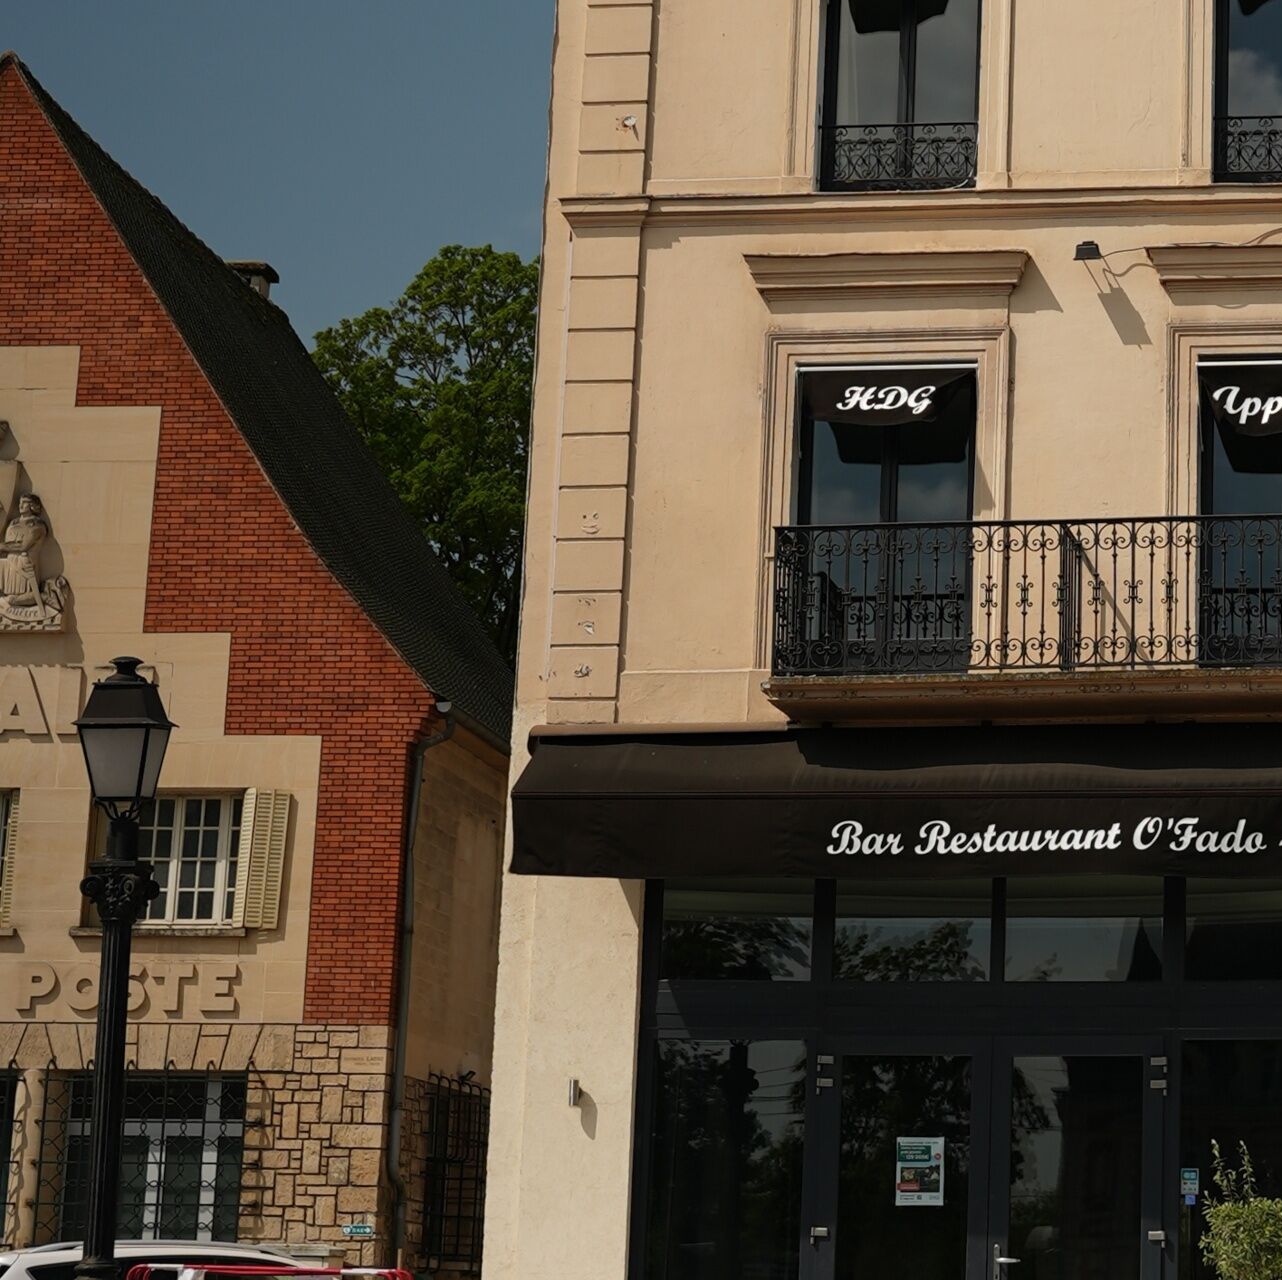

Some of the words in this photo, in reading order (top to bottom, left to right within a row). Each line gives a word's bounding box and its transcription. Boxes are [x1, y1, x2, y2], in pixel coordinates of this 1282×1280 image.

[836, 385, 936, 415] HDG
[826, 820, 904, 855] Bar
[914, 819, 1121, 855] Restaurant
[1132, 816, 1267, 854] O'Fado
[15, 961, 240, 1016] POSTE
